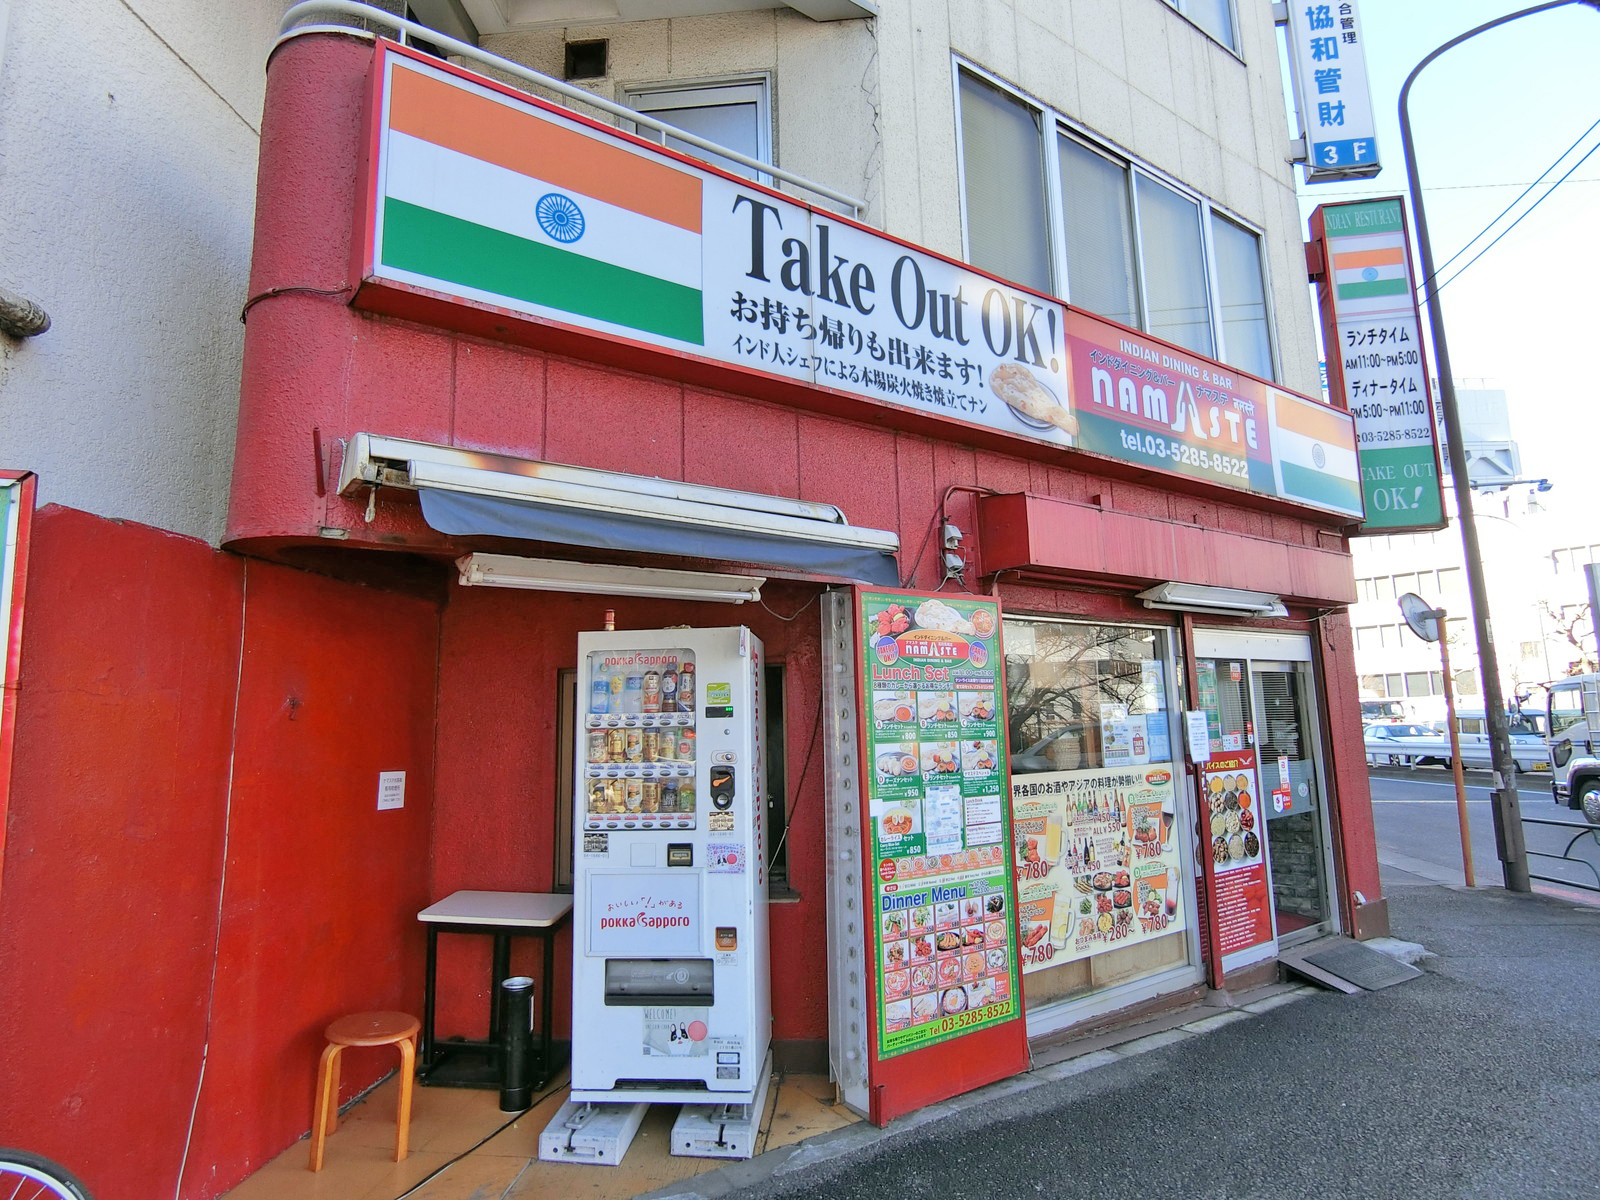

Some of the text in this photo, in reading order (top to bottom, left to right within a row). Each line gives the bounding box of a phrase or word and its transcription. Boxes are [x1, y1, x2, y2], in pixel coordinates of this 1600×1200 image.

[1338, 0, 1358, 45] 合管理
[1304, 4, 1346, 127] 協和管財
[1325, 213, 1352, 231] NDIAN
[732, 194, 1060, 374] Take Out OK!
[730, 290, 985, 388] お持ち帰りも出来ます!
[1346, 326, 1410, 347] ランチタイム
[732, 333, 988, 415] インド人シェフによる本場炭火焼き焼立てナン
[1089, 348, 1176, 387] インドダイニング&バー
[1119, 338, 1233, 390] INDIAN DINING & BAR
[1195, 384, 1229, 406] ナマステ
[1351, 376, 1418, 398] ディナータイム
[1361, 427, 1431, 443] 03-5285-8522
[1120, 428, 1250, 480] tel.03-5285-8522
[1403, 462, 1434, 479] OUT
[1373, 485, 1424, 512] OK!
[604, 657, 634, 667] pokka
[872, 664, 950, 681] Lunch Set
[1136, 840, 1162, 860] ¥780
[881, 886, 967, 911] Dinner Menu
[600, 911, 690, 930] pokka sapporo
[1141, 913, 1168, 934] ¥780
[929, 1001, 1012, 1036] Tel 03-5285-8522
